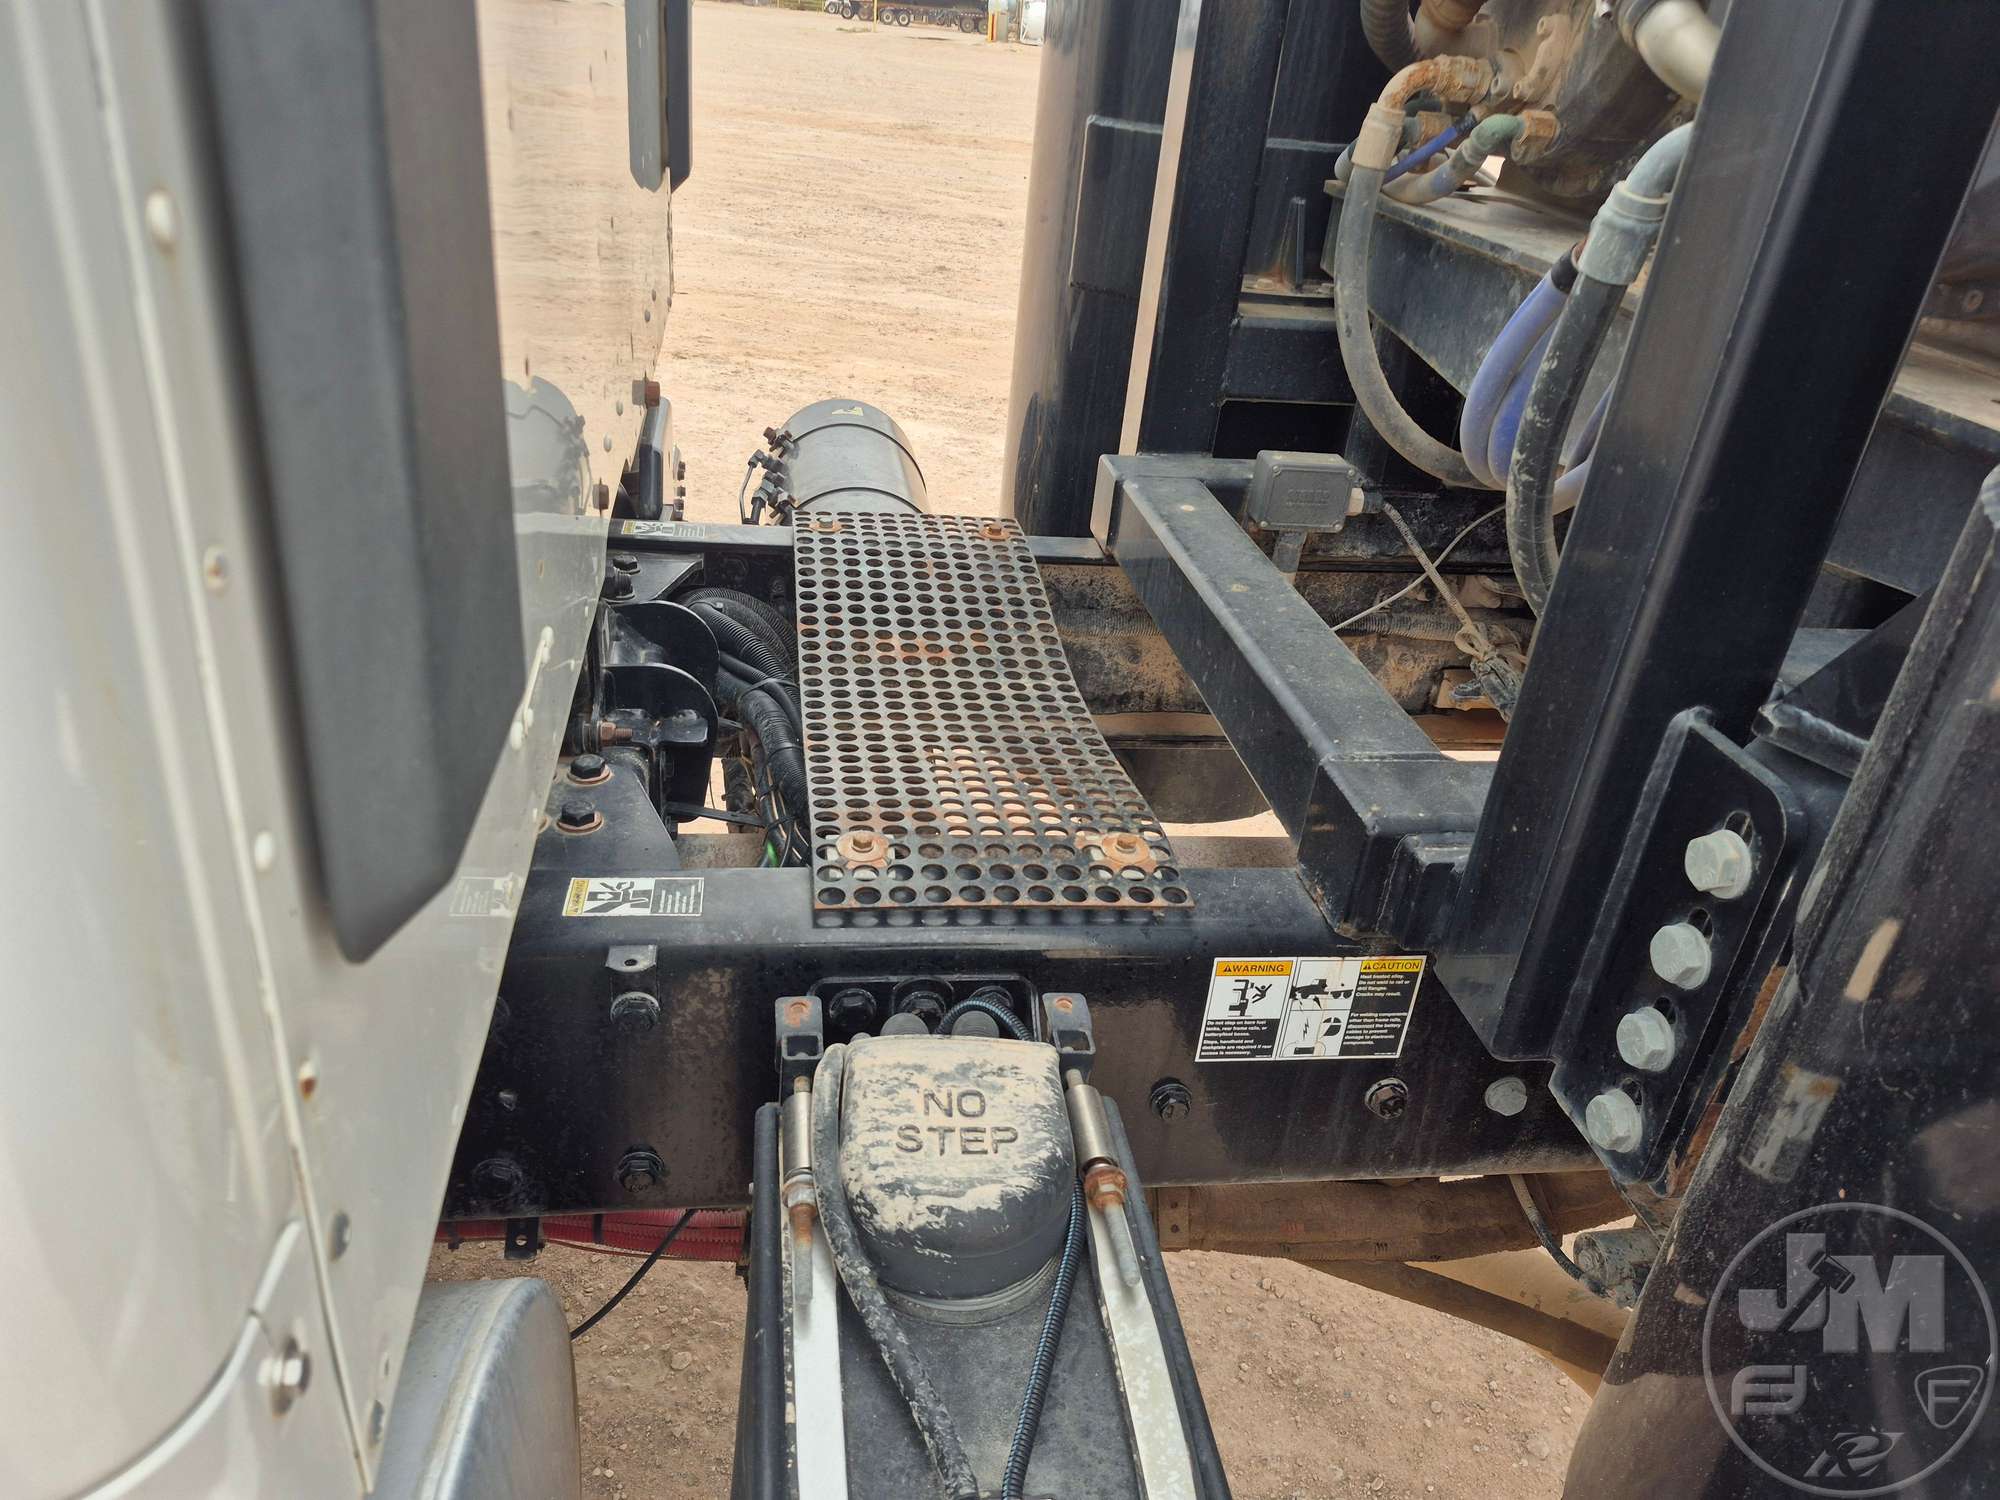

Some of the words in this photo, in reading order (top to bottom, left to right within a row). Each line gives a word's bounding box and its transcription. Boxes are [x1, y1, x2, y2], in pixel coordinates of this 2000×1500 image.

[1233, 964, 1284, 972] WARNING
[1372, 962, 1420, 970] CAUTION
[922, 1088, 986, 1118] NO
[895, 1124, 1018, 1156] STEP
